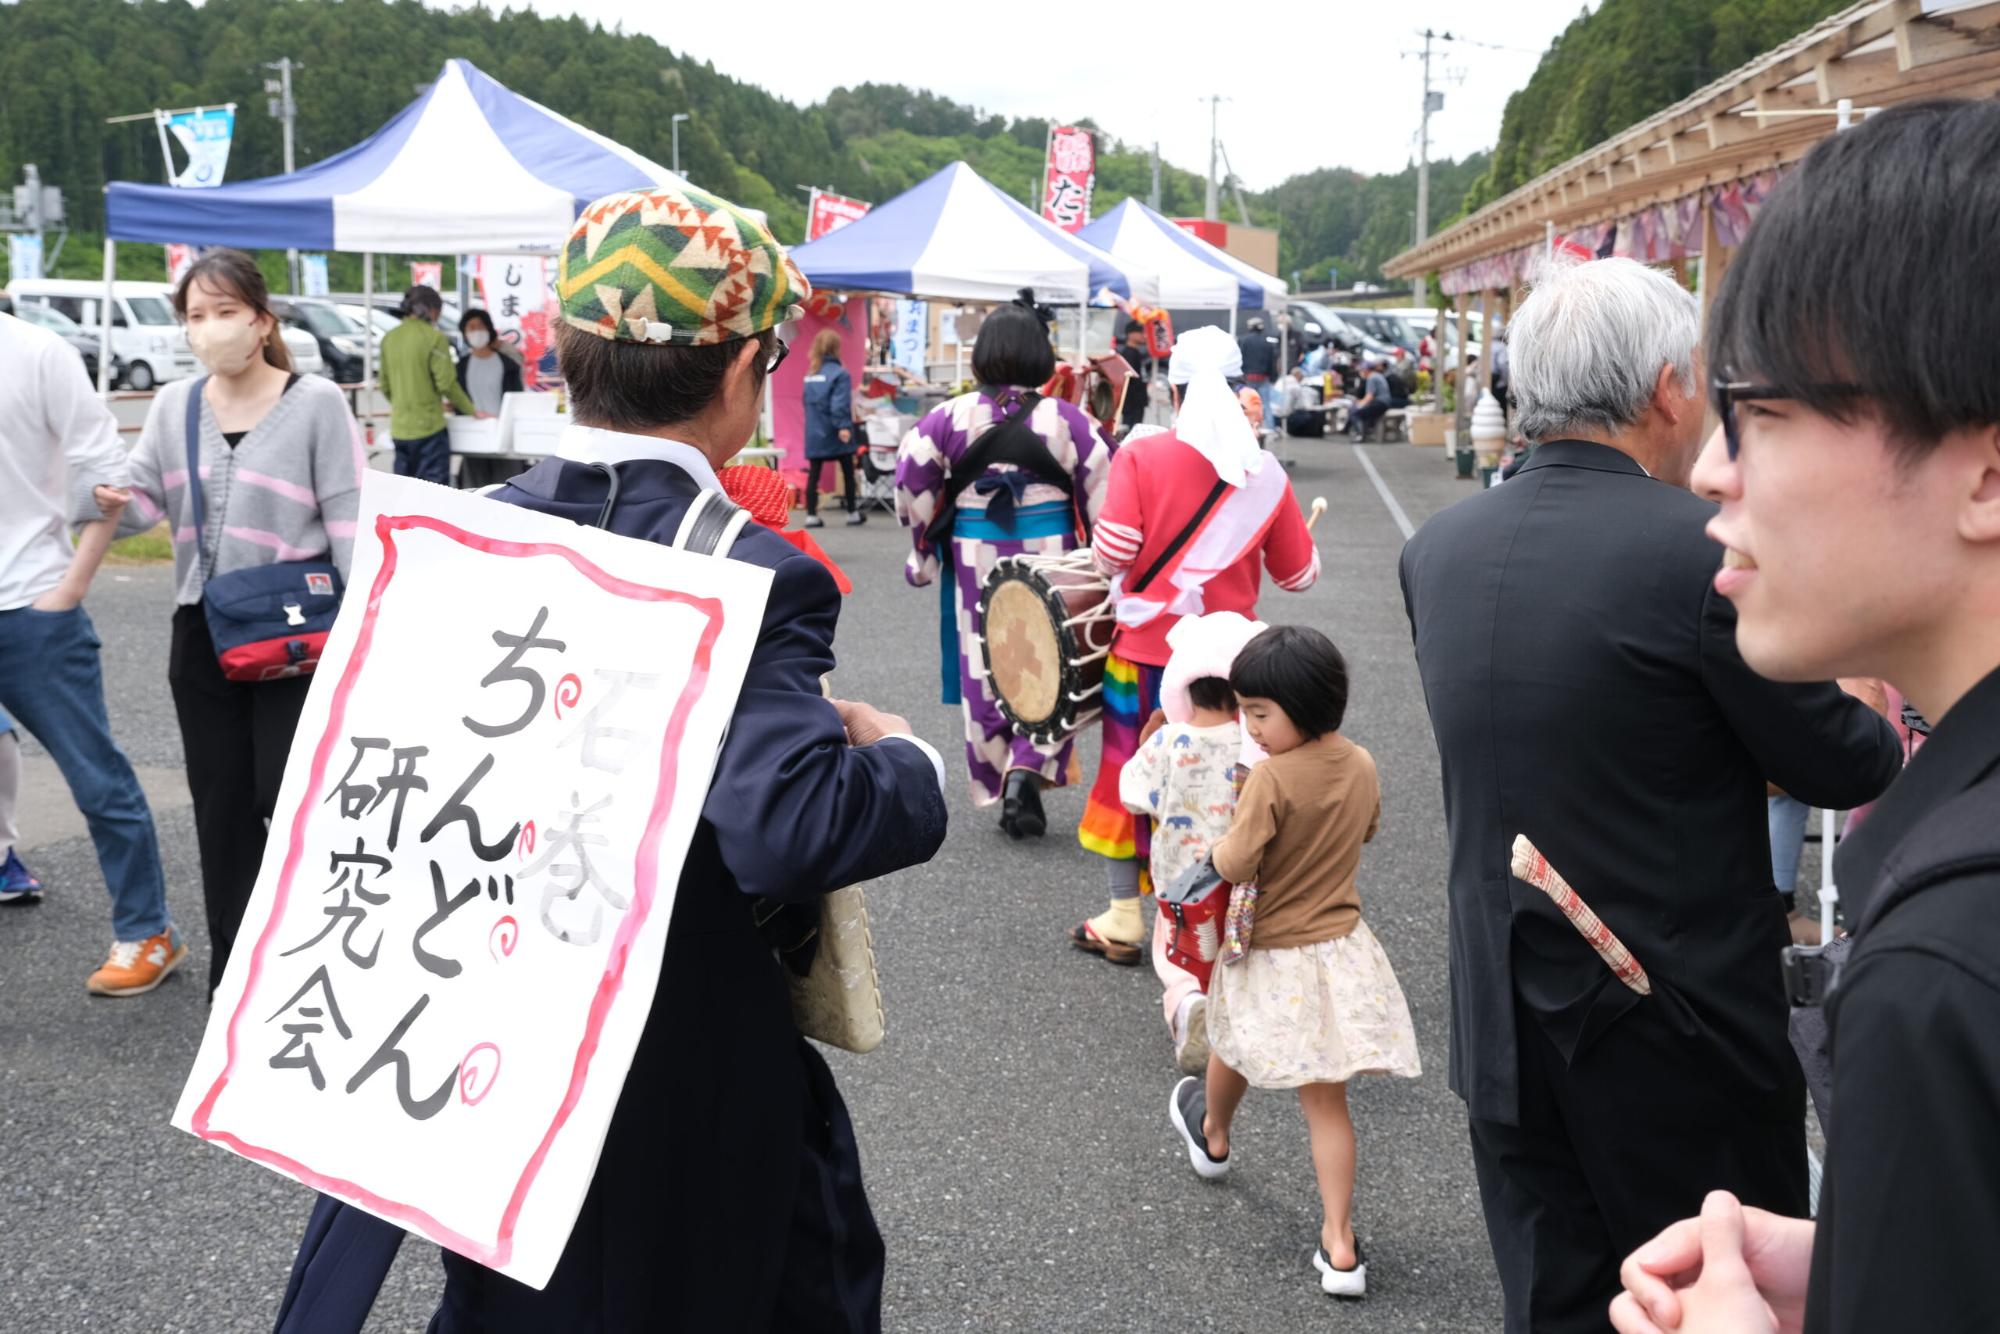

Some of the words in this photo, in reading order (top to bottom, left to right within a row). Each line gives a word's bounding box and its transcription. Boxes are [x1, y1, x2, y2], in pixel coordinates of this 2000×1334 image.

[266, 736, 429, 1091] 研究会
[346, 606, 567, 1121] ちんどん
[517, 668, 663, 947] 石巻
